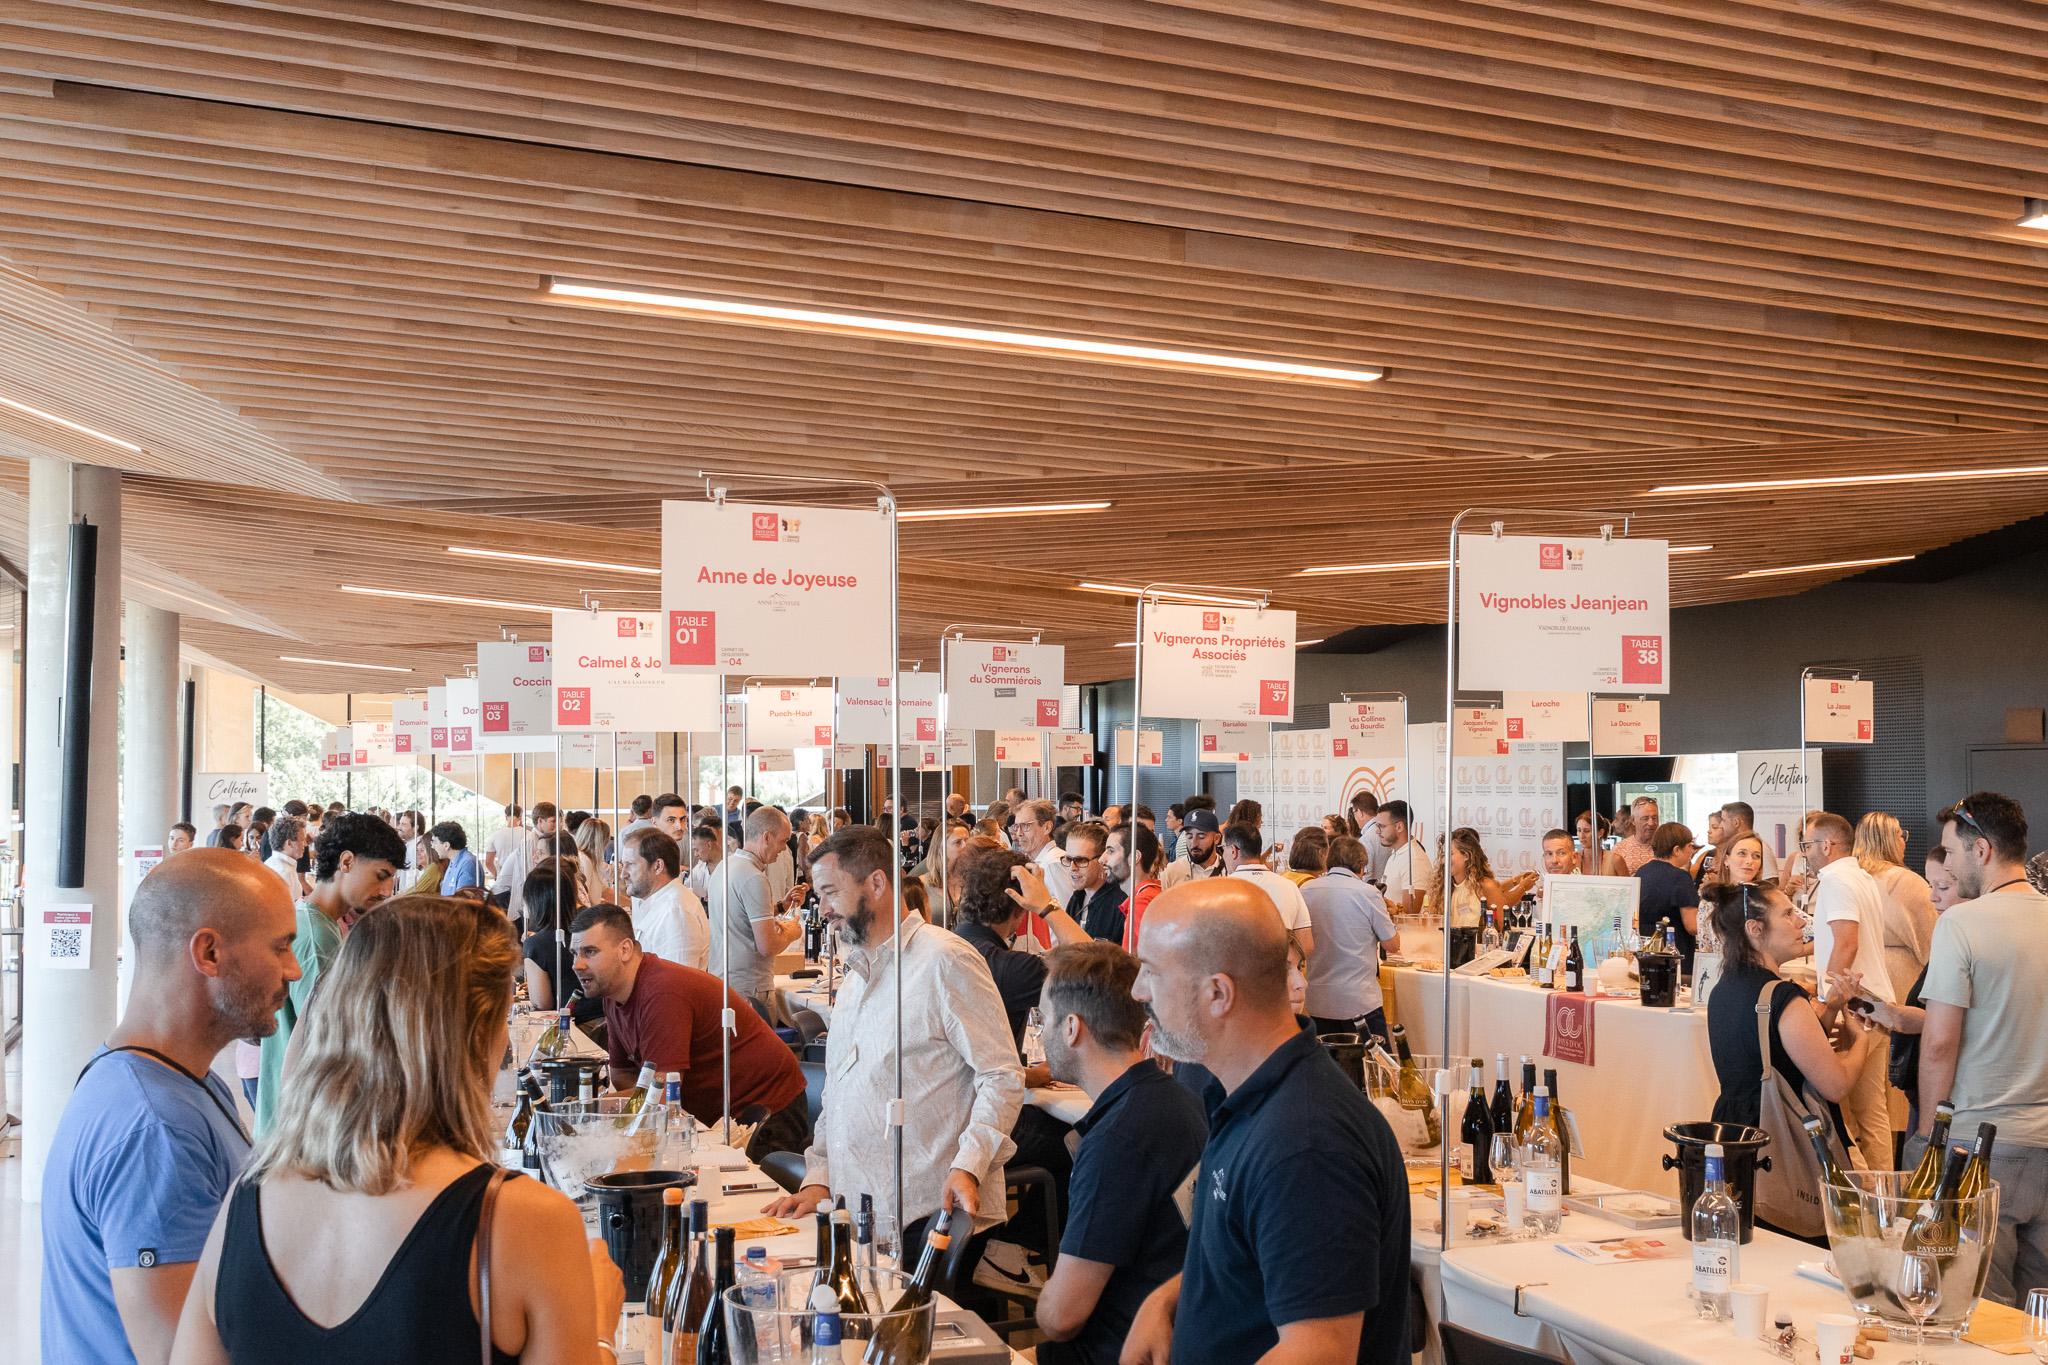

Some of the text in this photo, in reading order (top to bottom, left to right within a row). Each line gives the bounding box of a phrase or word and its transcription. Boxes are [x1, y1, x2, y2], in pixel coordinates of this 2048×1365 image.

[697, 566, 857, 591] Anne de Joyeuse
[1479, 592, 1648, 615] Vignobles Jeanjean
[676, 616, 708, 627] TABLE
[676, 628, 698, 645] 01
[1153, 632, 1286, 649] Vignerons Propriétés
[1630, 640, 1658, 648] TABLE
[1192, 648, 1247, 660] Associés
[1638, 650, 1659, 664] 38
[578, 656, 627, 668] Calmel
[631, 656, 641, 668] &
[729, 658, 742, 666] 04
[981, 663, 1031, 675] Vignerons
[513, 676, 552, 686] Coccin
[969, 674, 1042, 685] du Sommiérois
[845, 697, 883, 706] Valensac
[899, 699, 933, 707] omaine
[1272, 691, 1287, 701] 37
[562, 699, 581, 711] 02
[486, 711, 501, 720] 03
[1046, 708, 1057, 716] 36
[1750, 762, 1808, 794] Collection
[209, 779, 257, 800] Collection
[1696, 1265, 1727, 1274] ABATILLES
